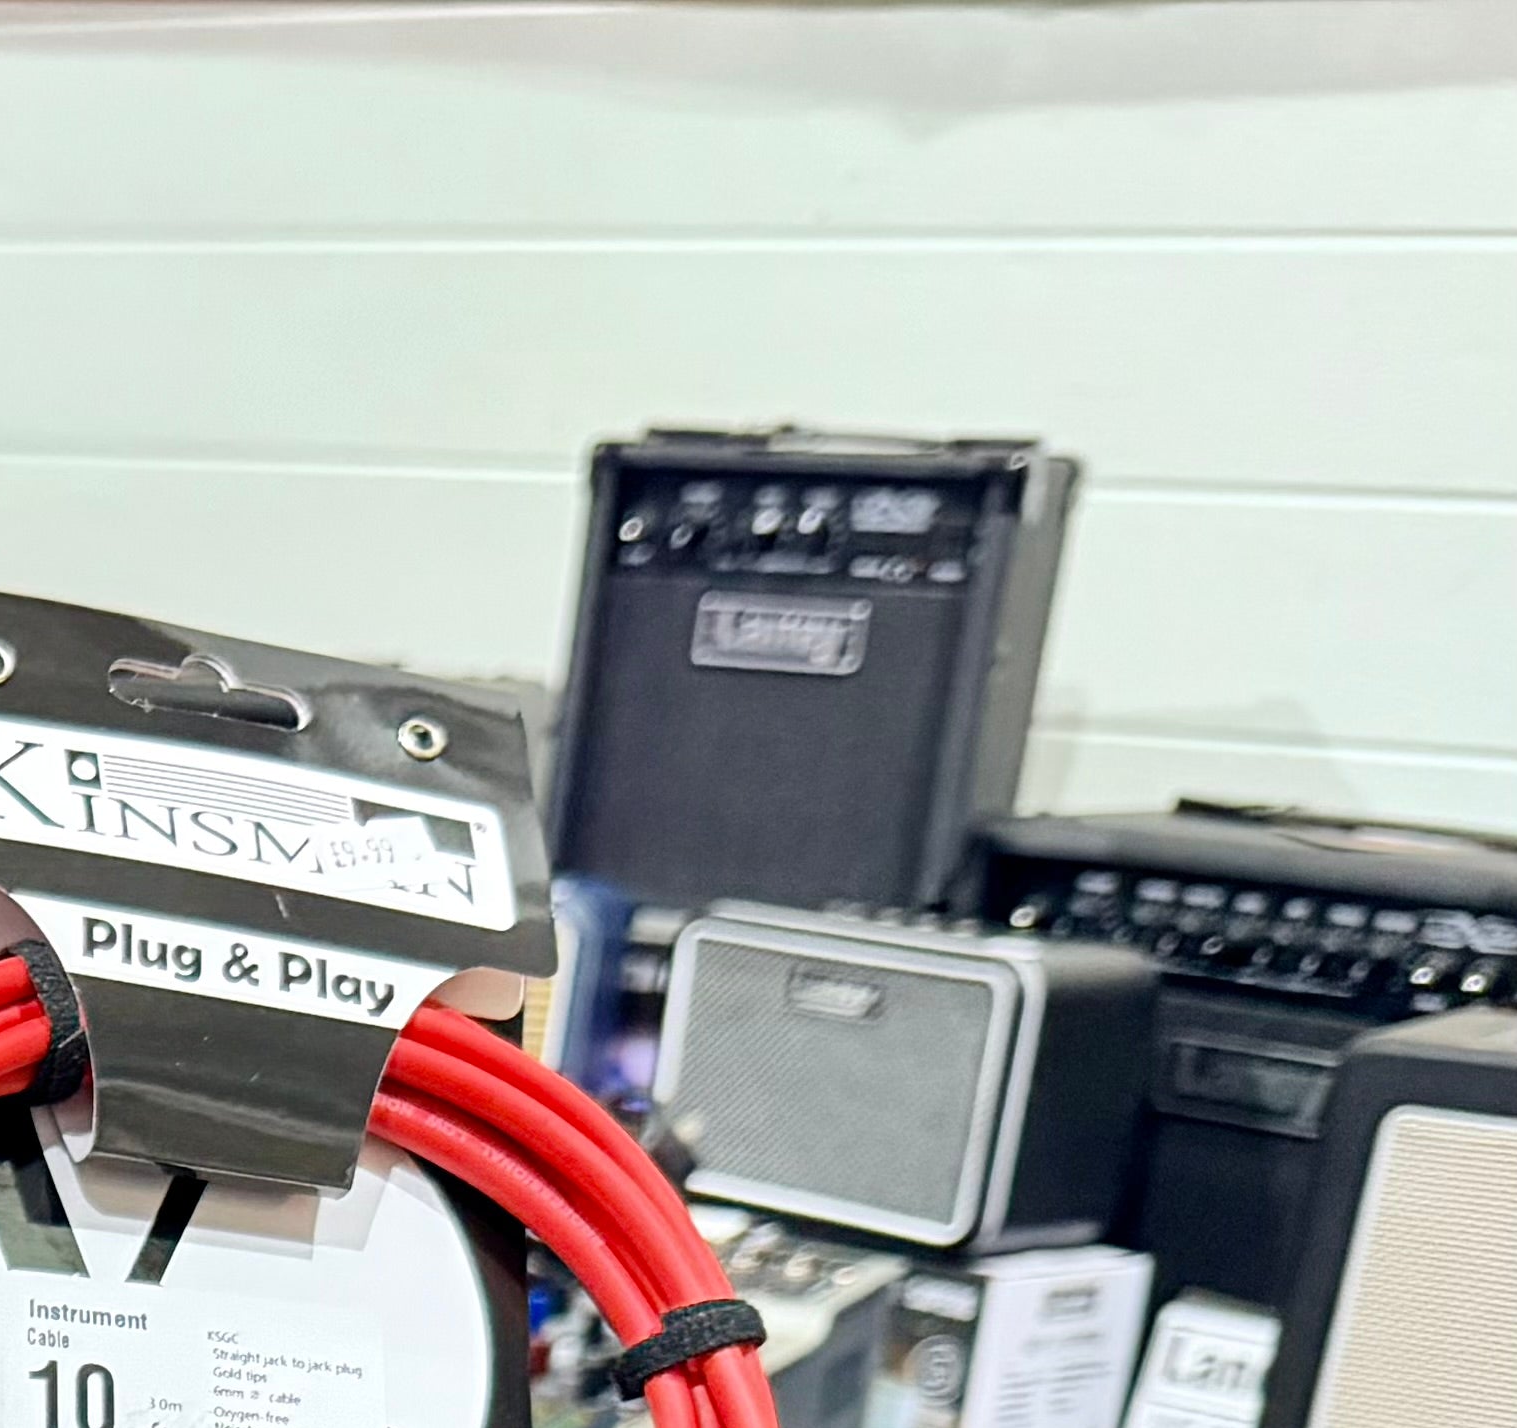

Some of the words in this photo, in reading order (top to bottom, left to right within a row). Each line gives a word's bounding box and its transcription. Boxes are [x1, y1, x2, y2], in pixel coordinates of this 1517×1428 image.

[81, 916, 203, 984] Plug
[222, 943, 261, 985] &
[278, 952, 396, 1019] Play
[28, 1298, 149, 1332] Instrument
[26, 1326, 71, 1350] Cable
[206, 1330, 240, 1345] KSGC
[212, 1347, 261, 1366] Straight
[262, 1355, 288, 1368] jack
[291, 1357, 306, 1370] to
[306, 1357, 333, 1374] jack
[335, 1362, 364, 1380] plug
[212, 1366, 243, 1381] Gold
[246, 1370, 269, 1384] tips
[268, 1392, 302, 1407] cable
